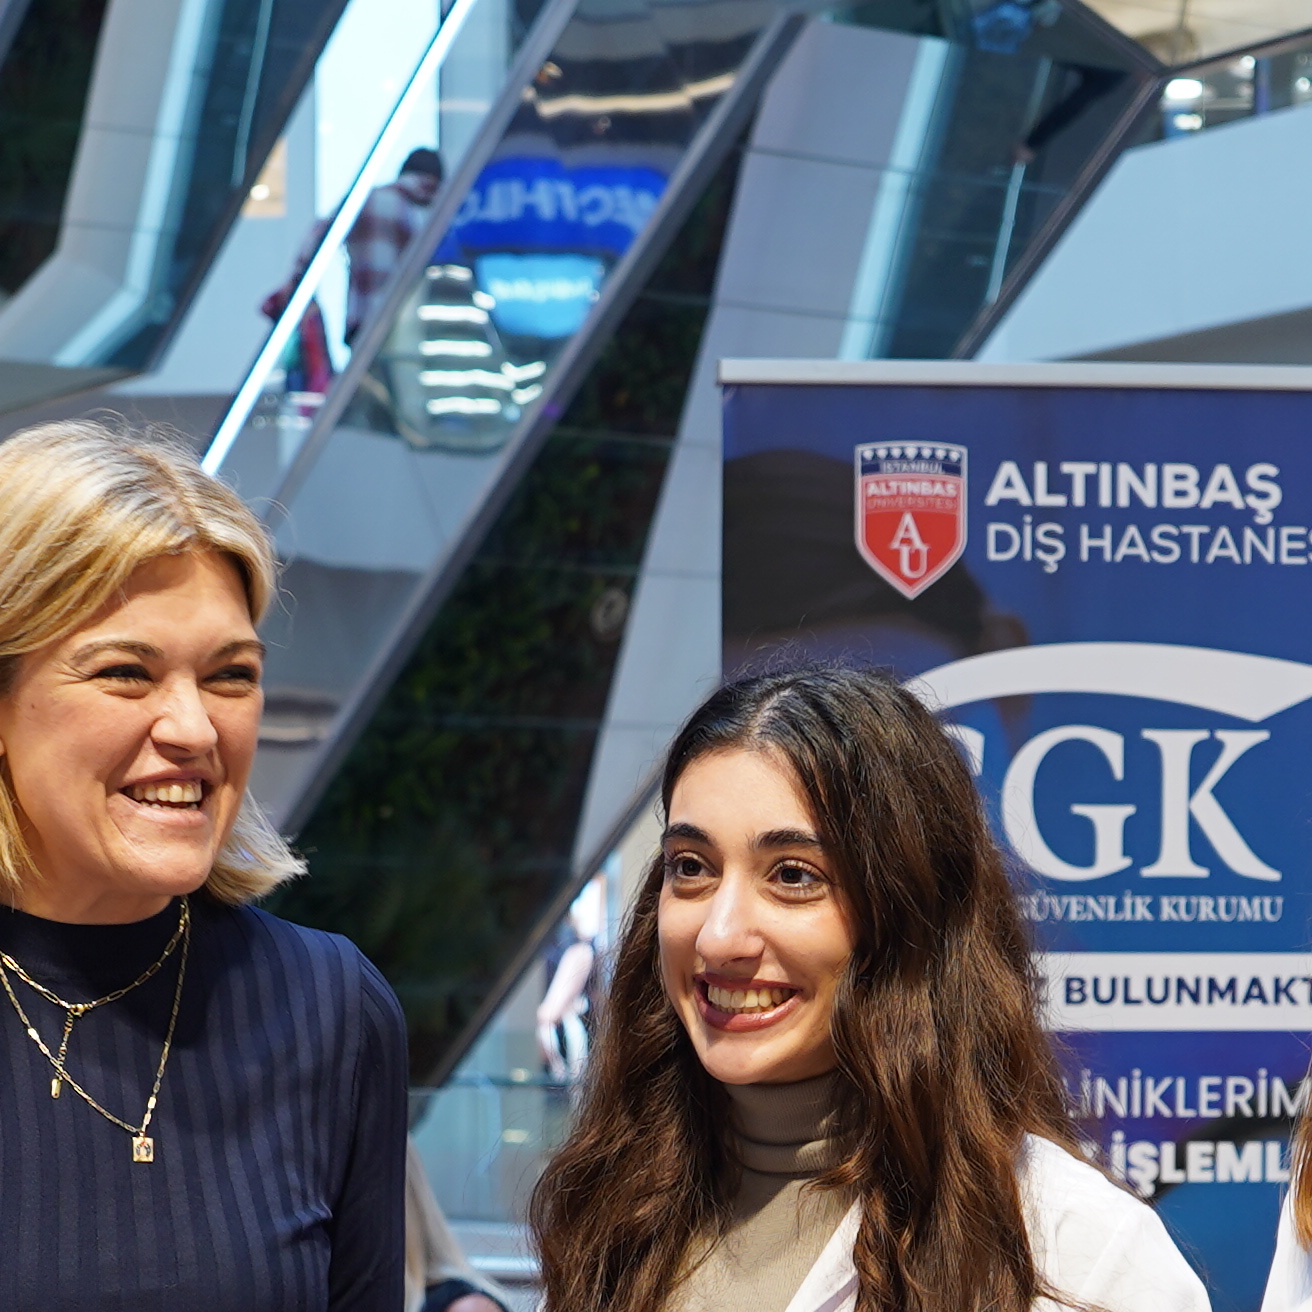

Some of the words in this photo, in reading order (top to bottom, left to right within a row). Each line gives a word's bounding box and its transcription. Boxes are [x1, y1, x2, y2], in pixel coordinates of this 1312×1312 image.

[984, 460, 1283, 525] ALTINBAŞ
[986, 514, 1067, 573] DİŞ
[1159, 895, 1285, 922] KURUMU
